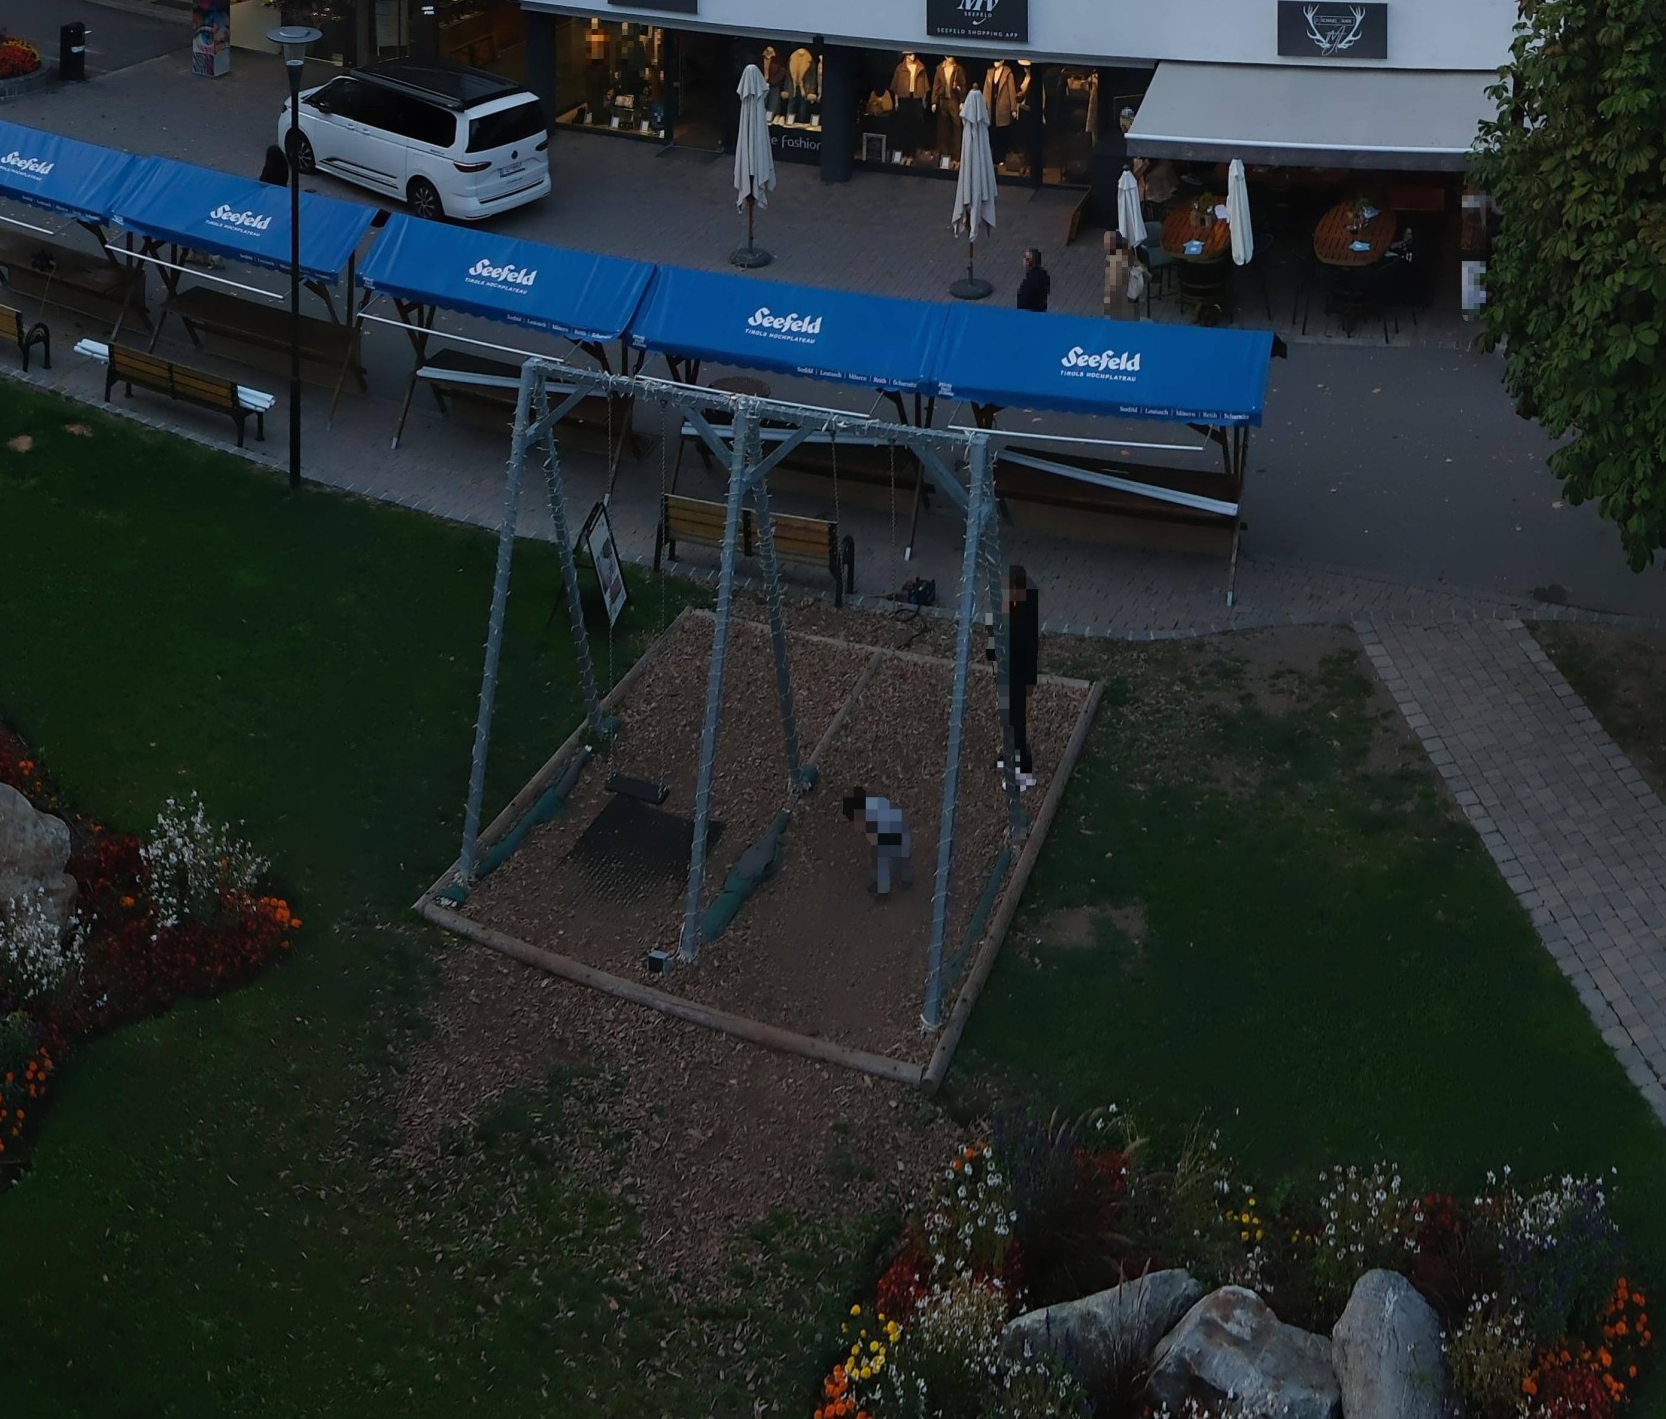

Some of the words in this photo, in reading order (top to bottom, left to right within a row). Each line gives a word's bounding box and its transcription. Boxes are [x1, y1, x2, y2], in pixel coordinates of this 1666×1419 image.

[968, 29, 1003, 37] SHOPPING
[1, 151, 55, 175] Seefeld
[210, 204, 272, 230] Seefeld
[469, 259, 537, 286] Seefeld
[748, 307, 823, 334] Seefeld
[1061, 346, 1140, 371] Seefeld
[1060, 370, 1084, 378] TIROLS
[1085, 372, 1136, 382] HOCHPLATEAU
